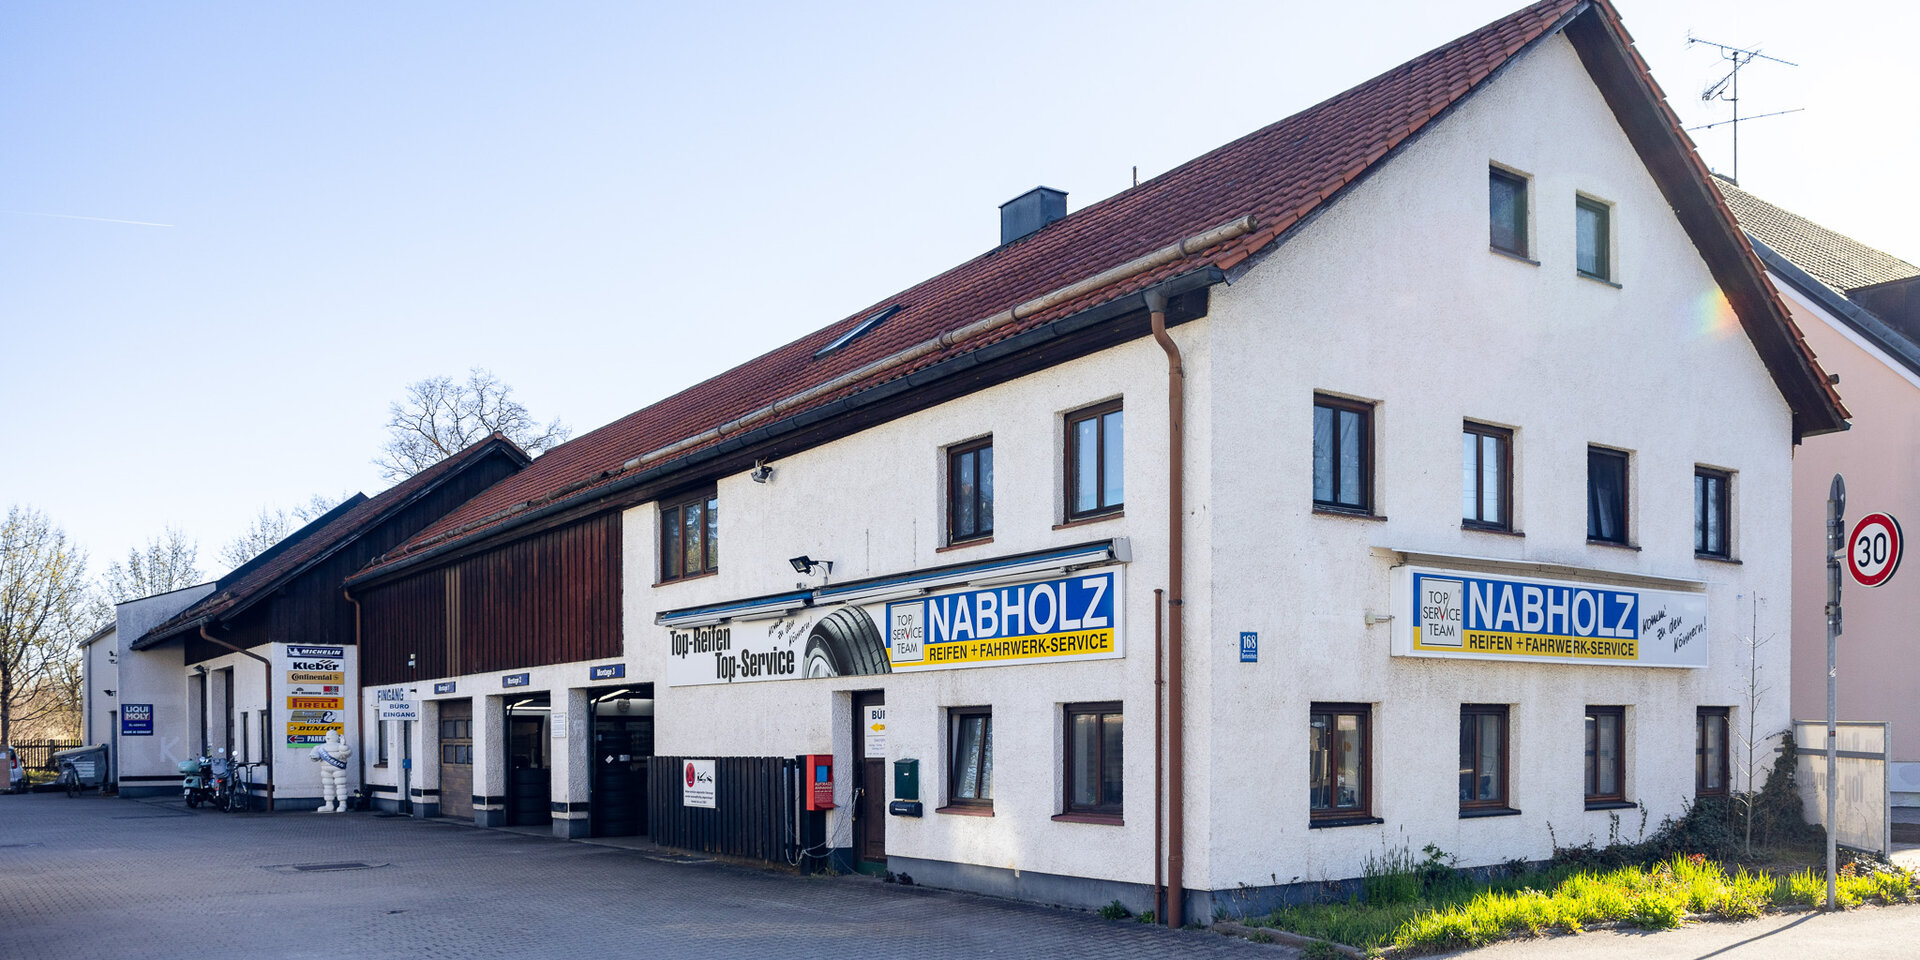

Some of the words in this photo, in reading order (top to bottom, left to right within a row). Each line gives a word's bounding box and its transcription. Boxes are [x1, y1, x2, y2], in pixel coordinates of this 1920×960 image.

[1858, 532, 1887, 567] 30
[1429, 591, 1448, 604] TOP
[929, 576, 1108, 642] NABHOLZ
[1423, 606, 1460, 621] SERVICE
[1469, 581, 1635, 638] NABHOLZ
[897, 614, 912, 626] TOP
[892, 626, 922, 641] SERVICE
[1429, 623, 1455, 637] TEAM
[1657, 627, 1666, 640] zu
[1669, 616, 1682, 634] den
[670, 626, 730, 659] Top-Reifen
[897, 643, 917, 654] TEAM
[929, 644, 967, 661] REIFEN
[980, 633, 1108, 658] FAHRWERK-SERVICE
[1243, 635, 1256, 649] 168
[1469, 634, 1512, 651] REIFEN
[1525, 637, 1635, 656] FAHRWERK-SERVICE
[293, 661, 339, 670] Kleber
[715, 646, 794, 682] Top-Service
[291, 673, 332, 681] Continental
[292, 697, 338, 708] PIRELLI
